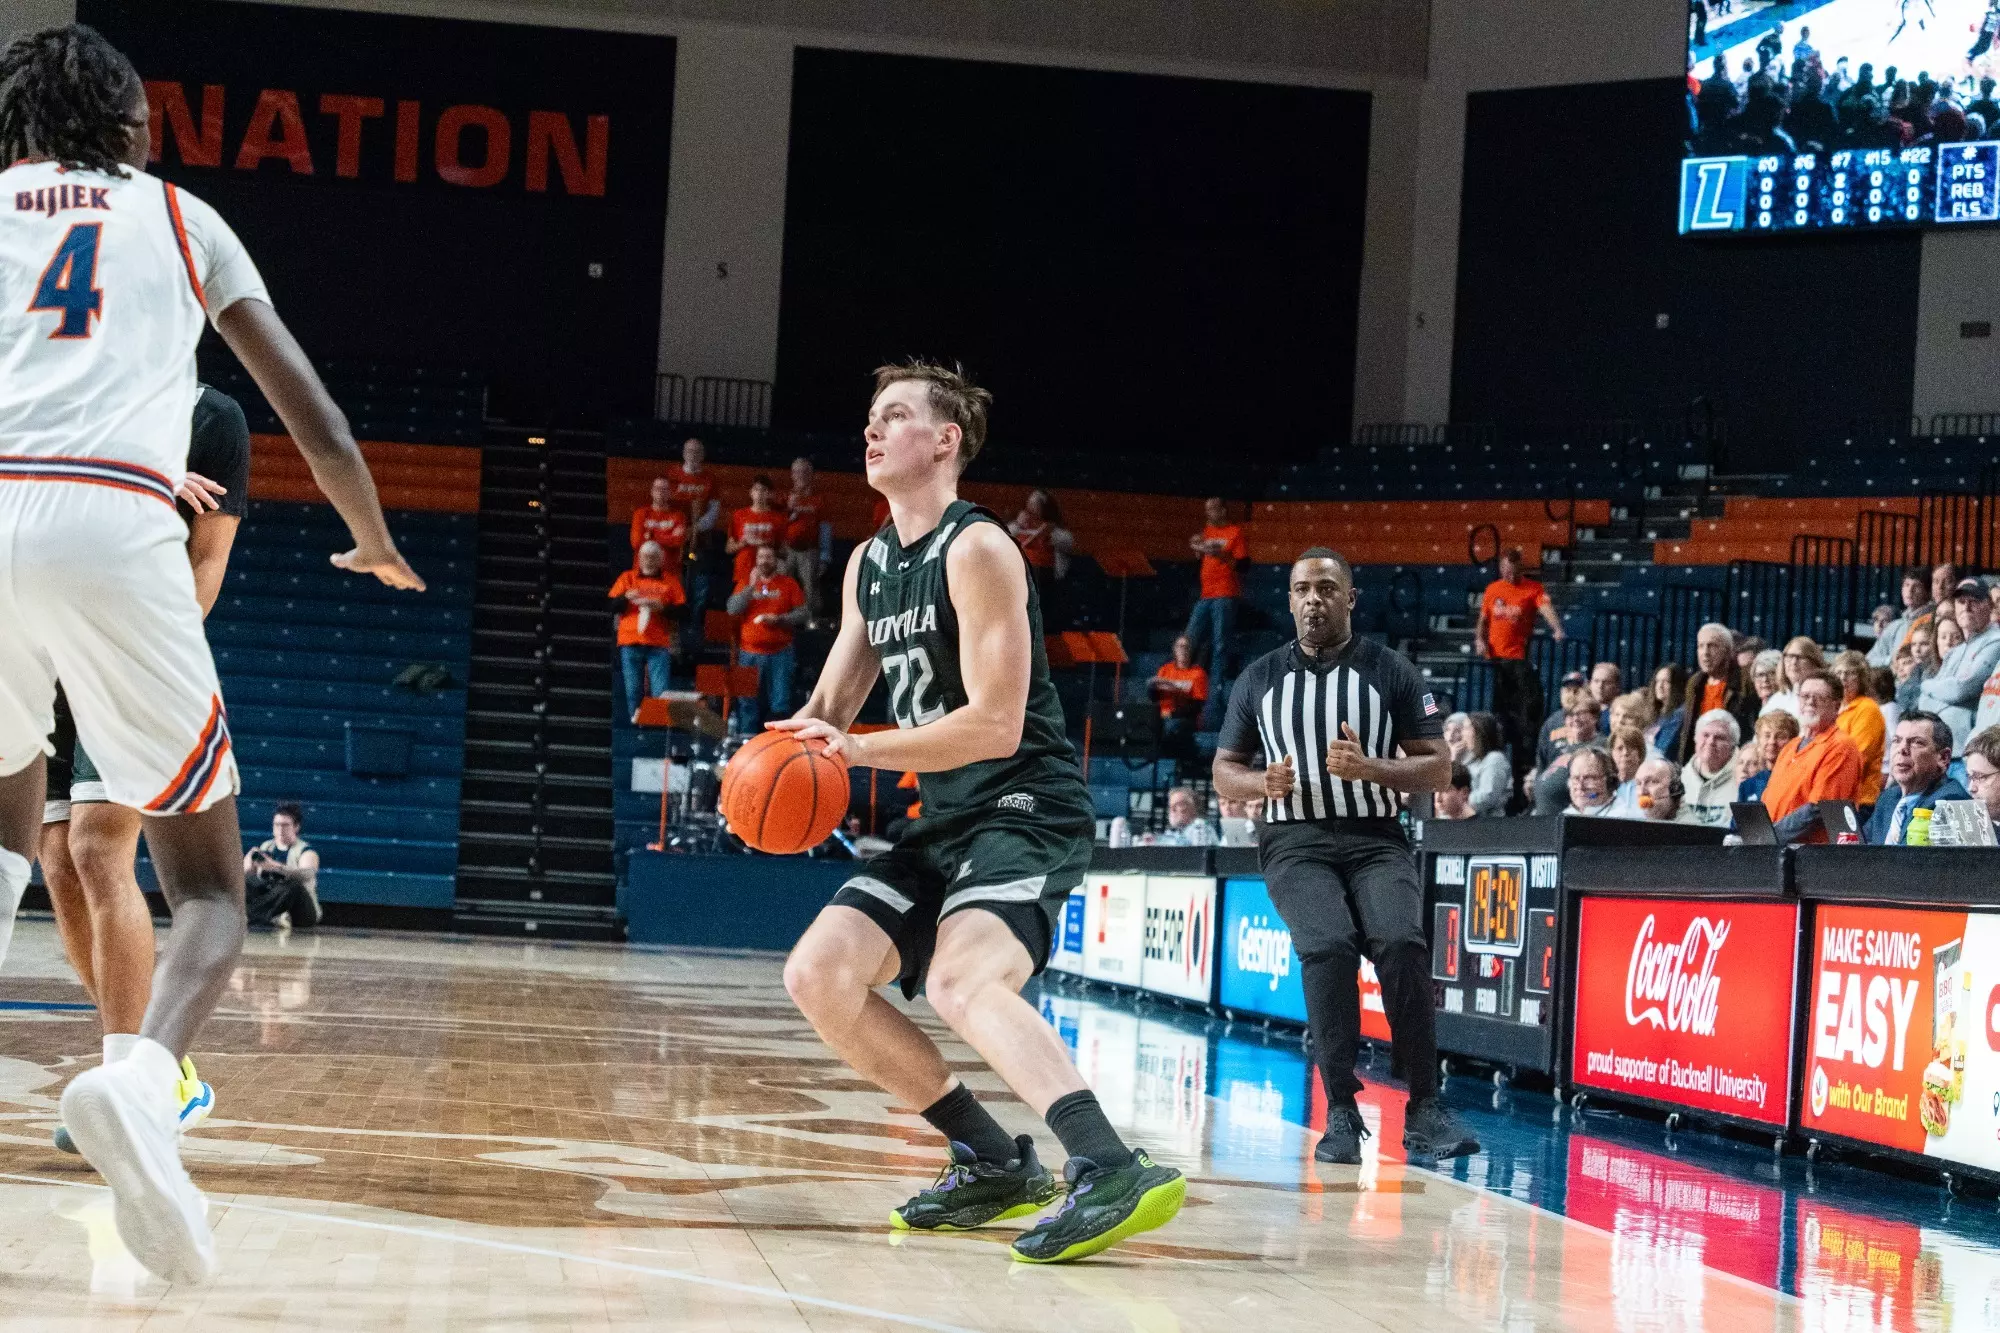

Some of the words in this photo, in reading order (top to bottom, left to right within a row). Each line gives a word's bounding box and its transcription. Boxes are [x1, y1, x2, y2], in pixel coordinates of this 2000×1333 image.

[142, 80, 610, 197] NATION
[1757, 156, 1779, 173] #0
[1831, 152, 1852, 171] #7
[1864, 149, 1892, 166] #15
[1900, 147, 1931, 164] #22
[1760, 176, 1773, 193] 0
[1796, 174, 1810, 191] 0
[1833, 172, 1847, 189] 2
[1870, 170, 1883, 187] 0
[1907, 168, 1921, 185] 0
[1952, 163, 1986, 180] PTS
[15, 184, 112, 219] BIJIEK
[1759, 194, 1772, 210] 0
[1795, 192, 1809, 208] 0
[1832, 190, 1845, 206] 0
[1869, 188, 1882, 205] 0
[1906, 186, 1920, 203] 0
[1951, 182, 1985, 199] REB
[1952, 200, 1982, 218] FLS
[1758, 211, 1772, 228] 0
[1794, 209, 1808, 226] 0
[1831, 207, 1844, 224] 0
[1868, 205, 1882, 223] 0
[1905, 203, 1919, 221] 0
[26, 222, 104, 340] 4
[867, 604, 937, 647] LOYOLA
[882, 646, 947, 730] 22
[1473, 869, 1520, 939] 19:04
[1823, 926, 1864, 964] MAKE
[1864, 929, 1921, 970] SAVING
[1815, 970, 1920, 1072] EASY
[1588, 1048, 1614, 1075] proud
[1614, 1056, 1658, 1083] supporter
[1659, 1058, 1670, 1084] of
[1671, 1060, 1713, 1093] Bucknell
[1714, 1068, 1768, 1109] University
[1829, 1079, 1851, 1110] with
[1853, 1083, 1873, 1113] Our
[1874, 1088, 1909, 1121] Brand
